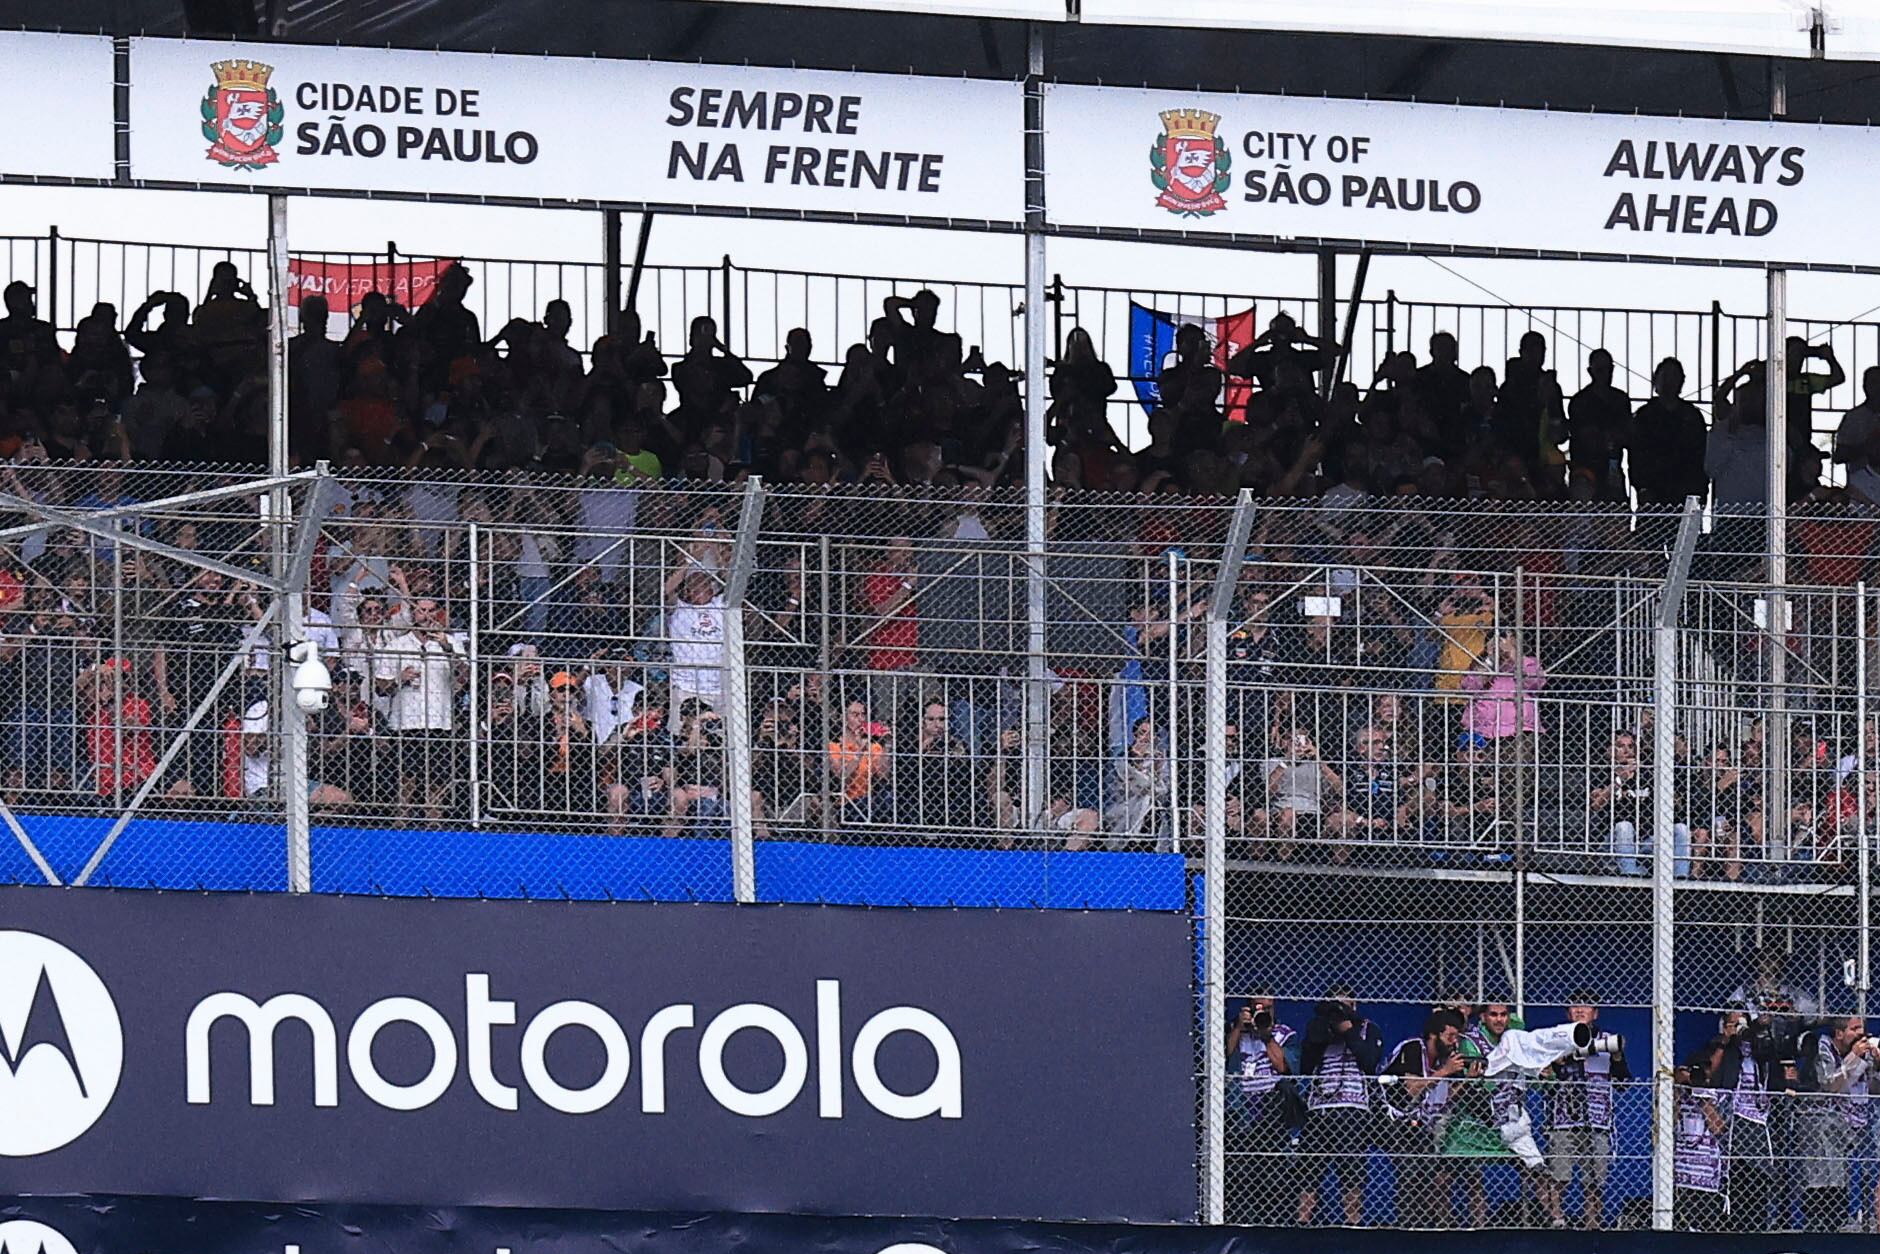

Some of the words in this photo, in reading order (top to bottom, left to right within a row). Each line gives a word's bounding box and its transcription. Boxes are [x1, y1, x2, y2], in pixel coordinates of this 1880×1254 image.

[296, 82, 423, 113] CIDADE
[435, 88, 480, 117] DE
[666, 86, 862, 135] SEMPRE
[296, 115, 386, 158] SÃO
[397, 126, 539, 165] PAULO
[1243, 130, 1317, 161] CITY
[1326, 135, 1370, 164] OF
[1603, 139, 1806, 187] ALWAYS
[667, 140, 744, 183] NA
[764, 145, 944, 193] FRENTE
[1244, 163, 1332, 206] SÃO
[1342, 175, 1481, 214] PAULO
[1604, 192, 1778, 237] AHEAD
[186, 973, 962, 1119] motorola
